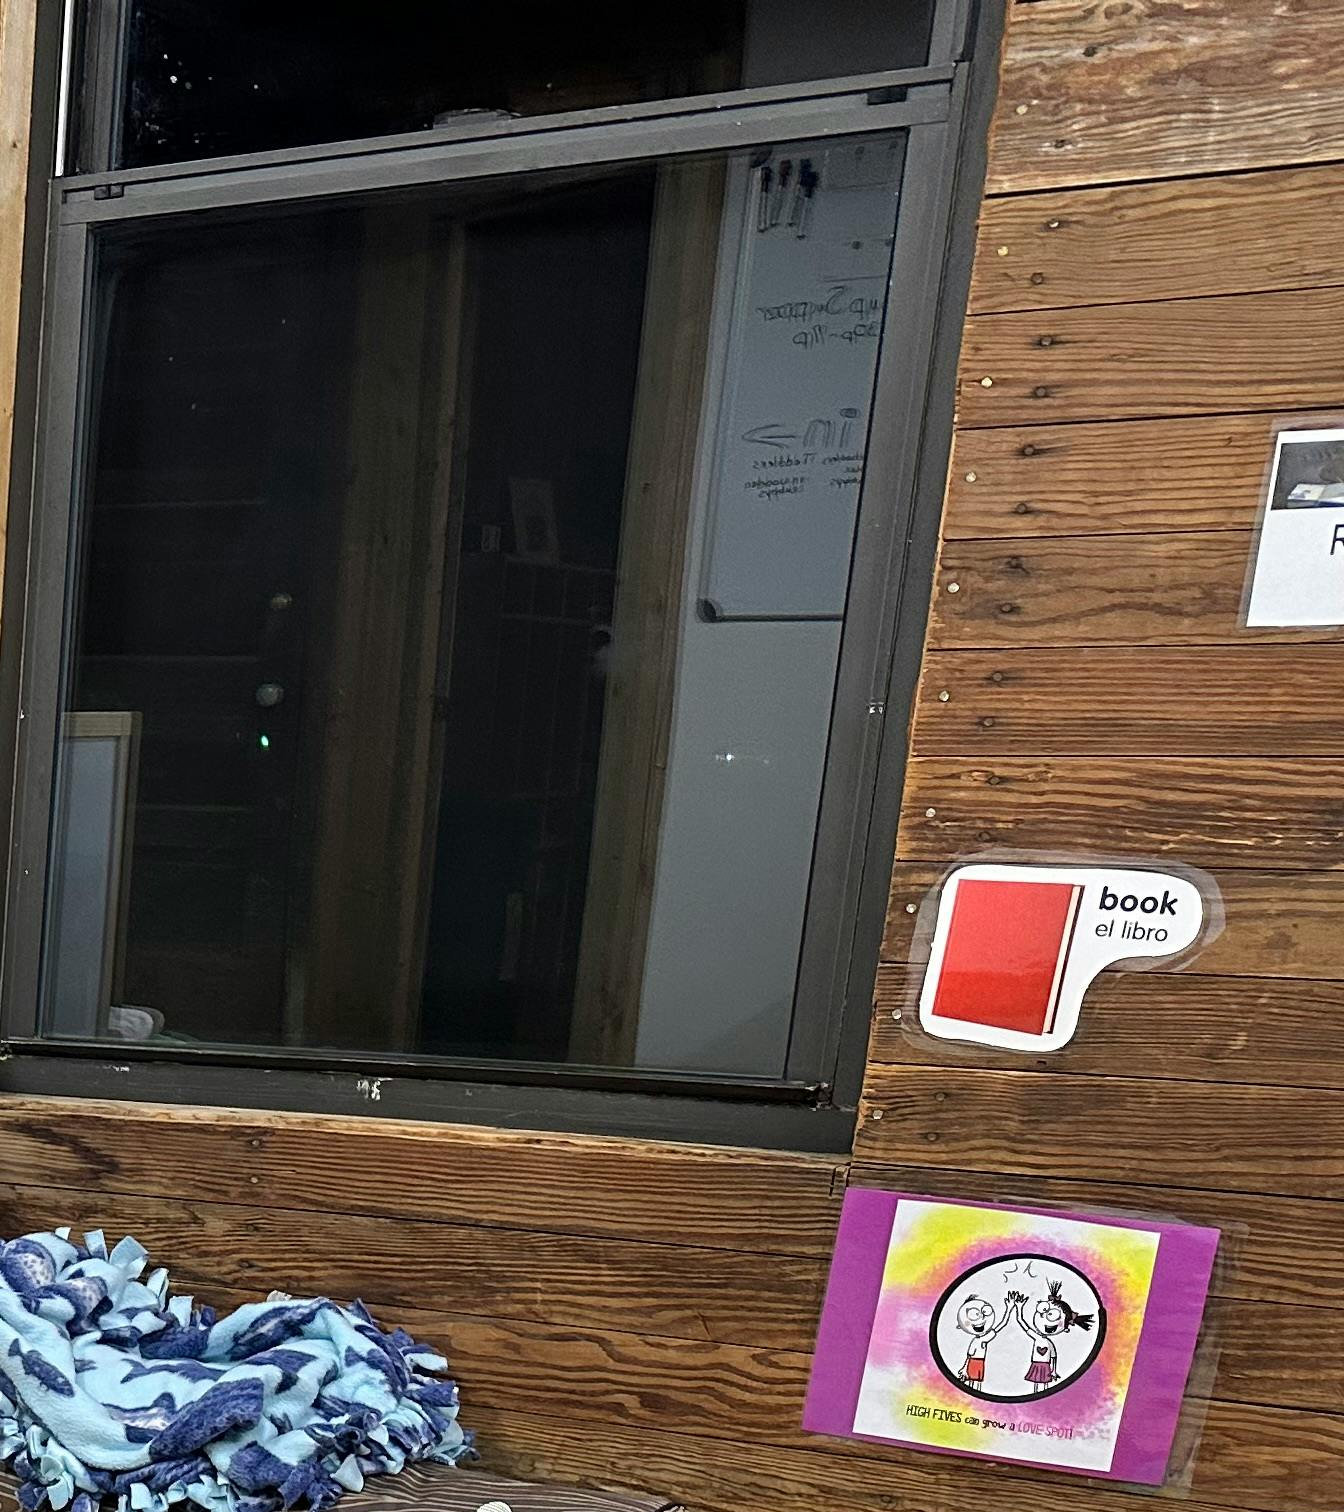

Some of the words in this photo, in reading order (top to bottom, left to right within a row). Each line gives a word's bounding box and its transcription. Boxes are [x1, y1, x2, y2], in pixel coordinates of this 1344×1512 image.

[1099, 886, 1178, 915] book
[1095, 919, 1114, 937] el
[1121, 920, 1168, 942] libro
[906, 1404, 930, 1419] HIGH
[933, 1409, 962, 1423] FIVES
[964, 1416, 979, 1425] can
[981, 1420, 1006, 1429] grow
[1009, 1423, 1015, 1431] a
[1018, 1422, 1045, 1435] LOVE
